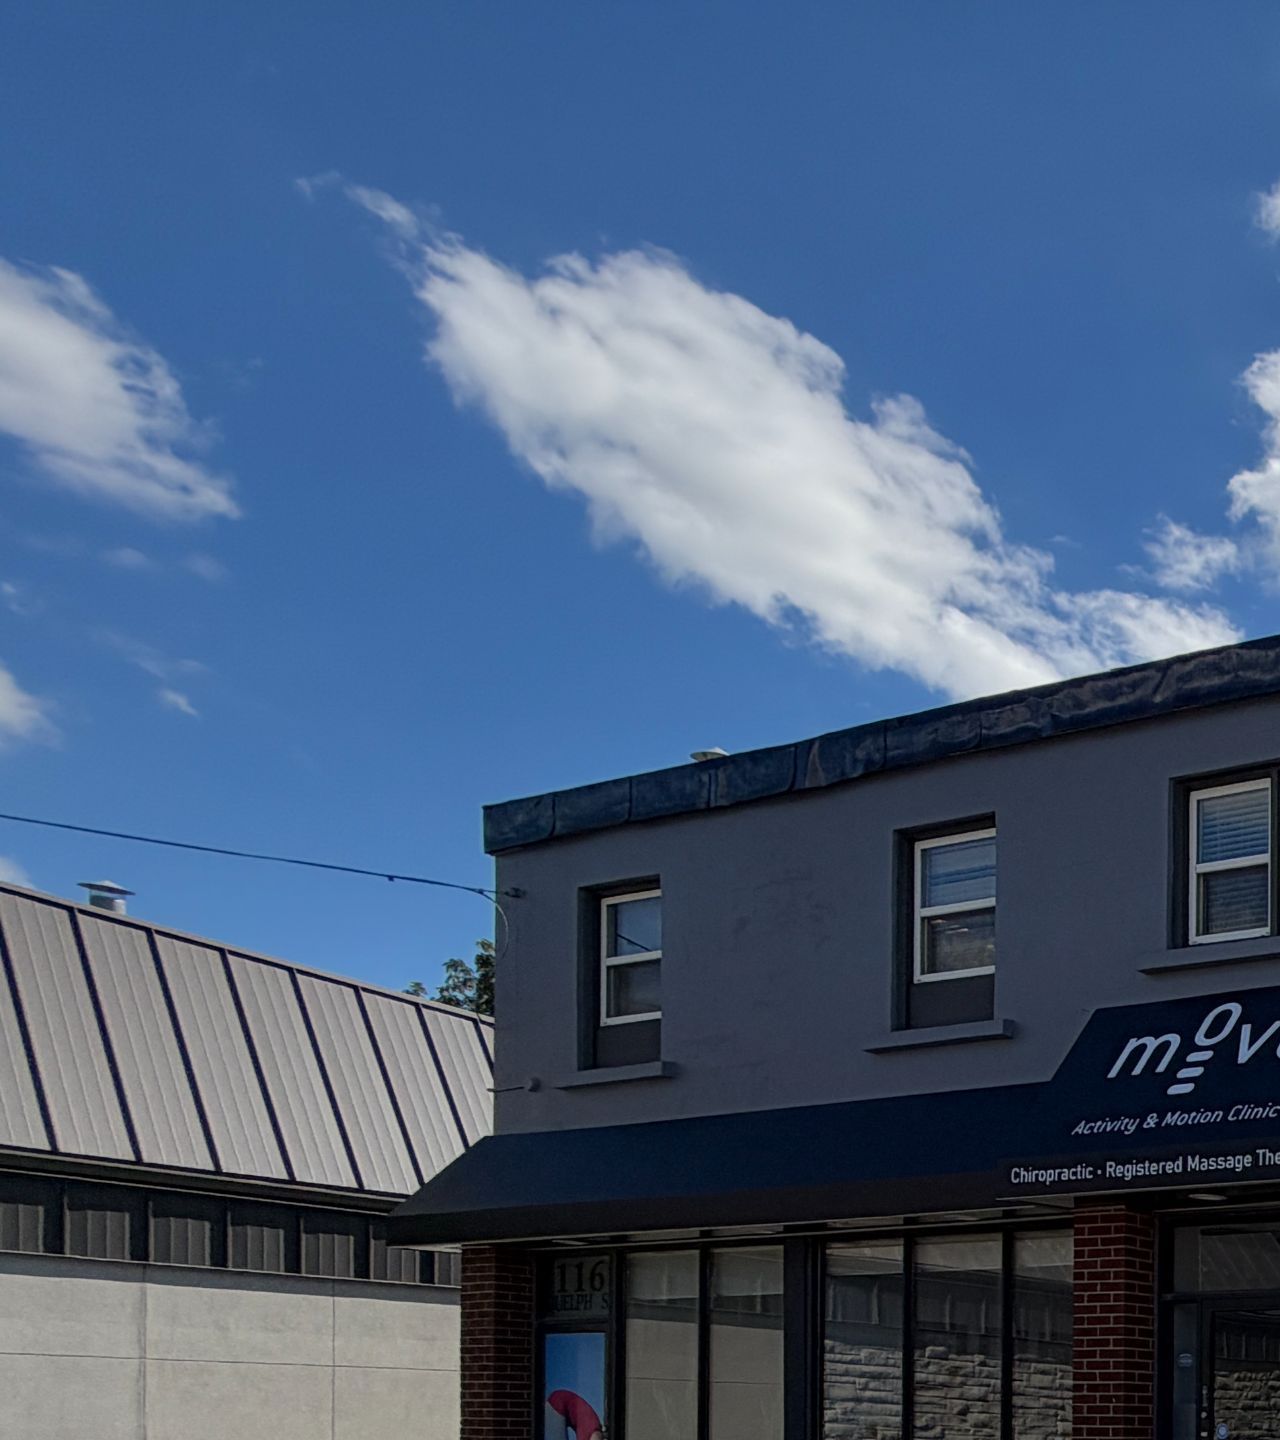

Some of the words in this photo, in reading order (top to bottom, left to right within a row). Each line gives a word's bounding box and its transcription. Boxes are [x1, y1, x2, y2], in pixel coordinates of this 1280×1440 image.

[1071, 1115, 1139, 1136] Activity
[1143, 1113, 1159, 1129] &
[1161, 1107, 1223, 1128] Motion
[1227, 1102, 1280, 1122] Clinic
[1011, 1163, 1094, 1185] Chiropractic
[1106, 1156, 1183, 1181] Registered
[1187, 1152, 1252, 1174] Massage
[557, 1260, 606, 1292] 116
